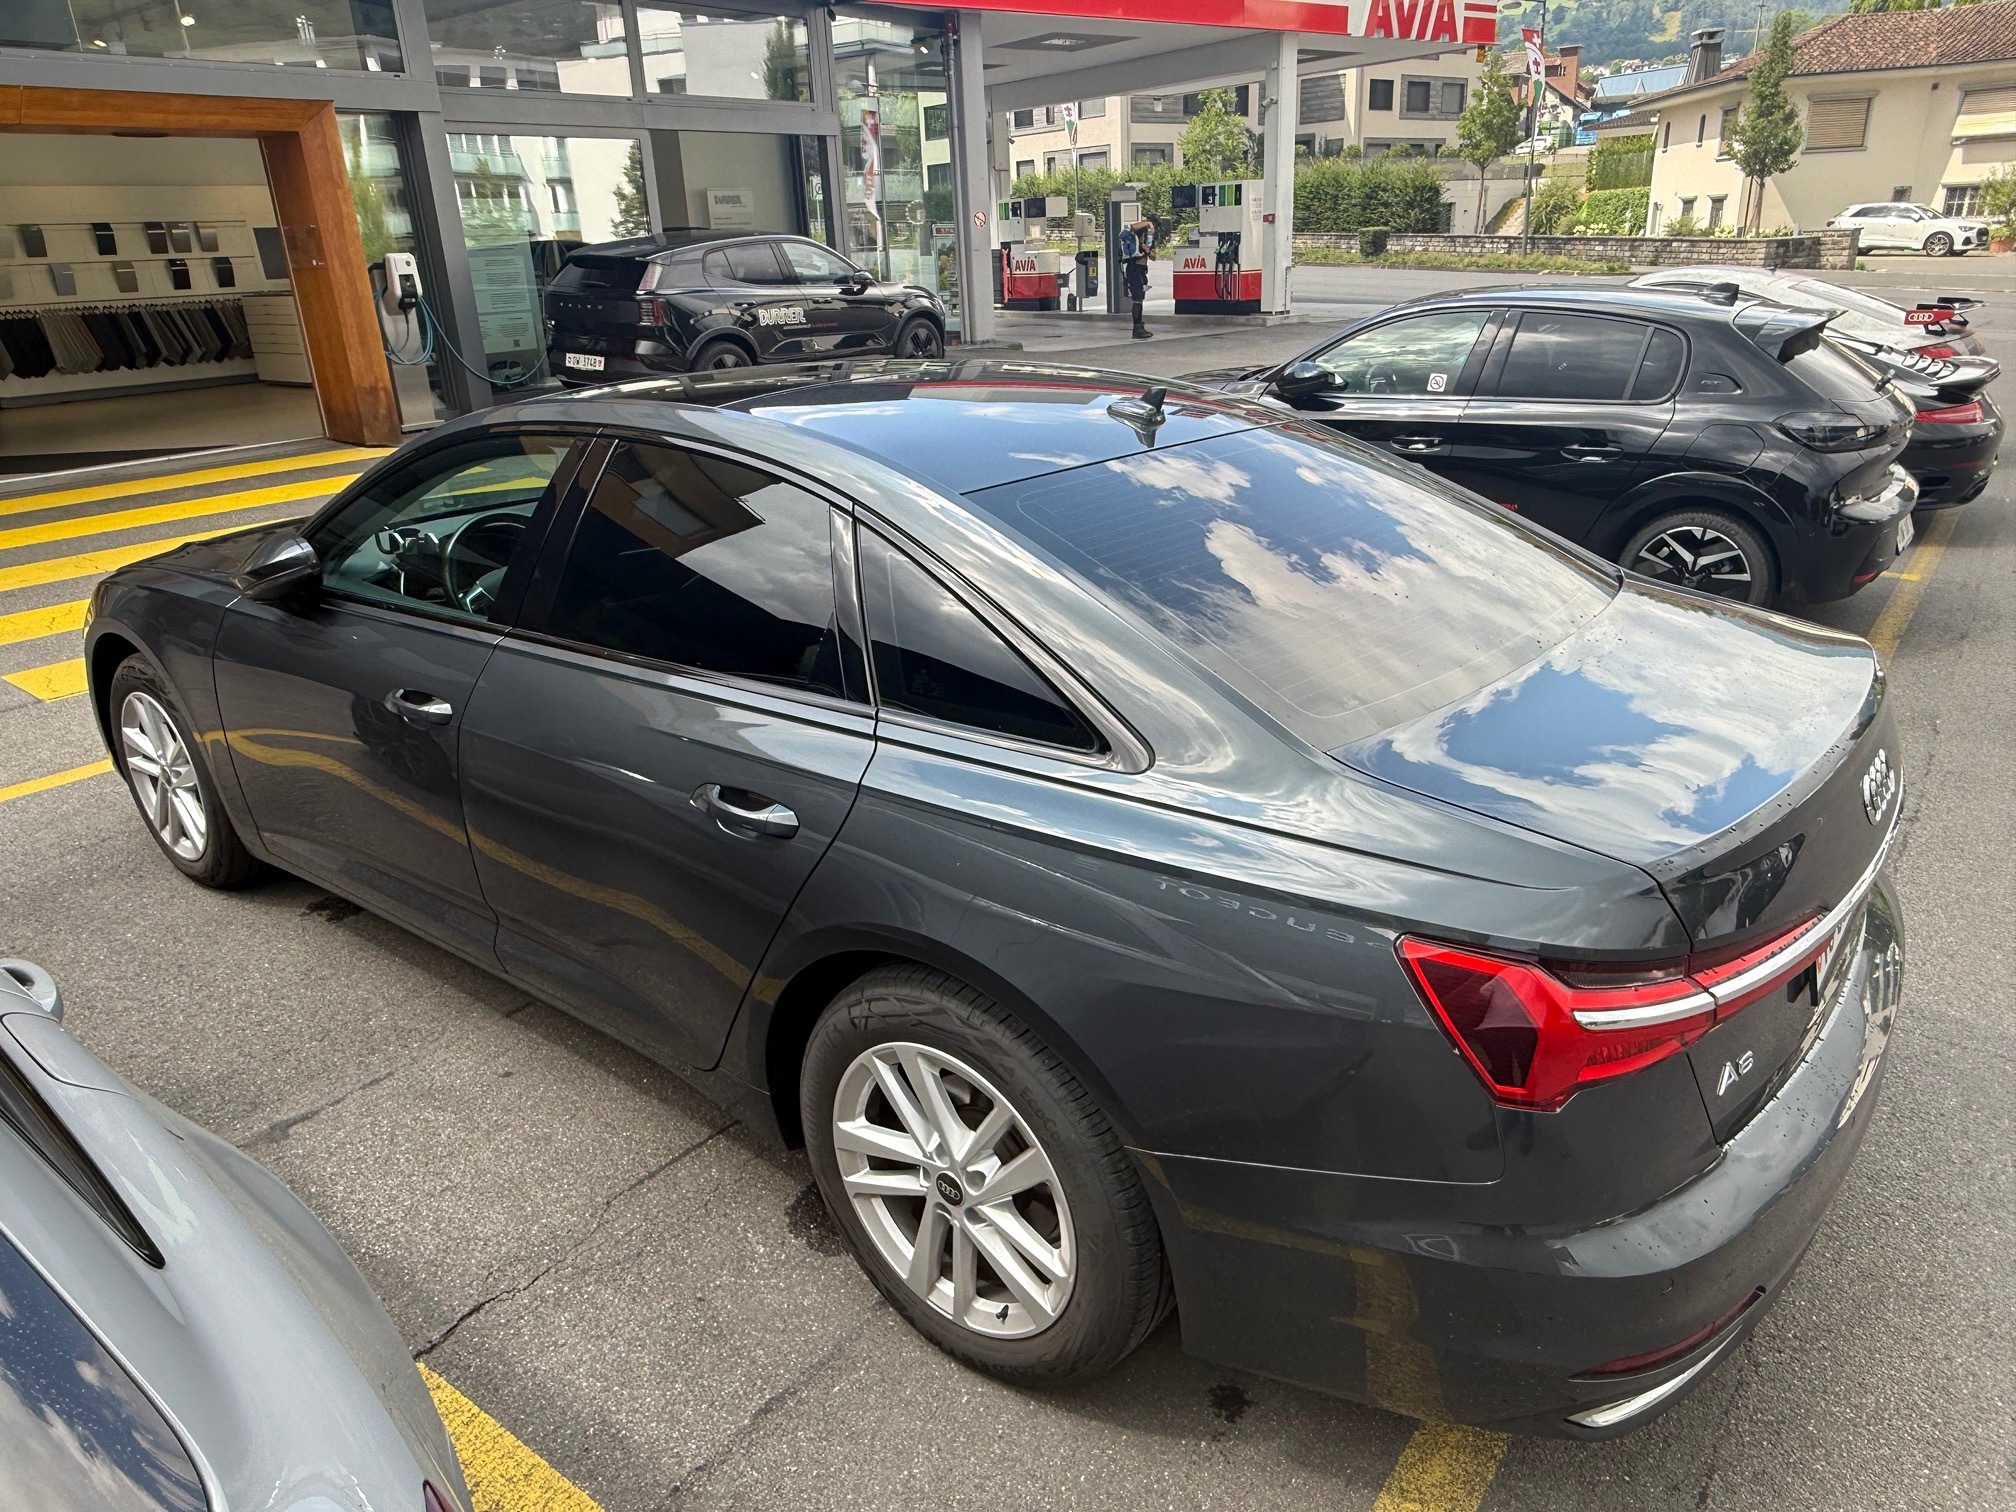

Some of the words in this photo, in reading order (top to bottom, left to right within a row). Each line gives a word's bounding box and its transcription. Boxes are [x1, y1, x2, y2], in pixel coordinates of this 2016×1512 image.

[1364, 0, 1458, 42] AVIA
[1014, 257, 1036, 271] AVIA
[1183, 255, 1207, 269] AVIA
[1716, 1051, 1754, 1096] A6
